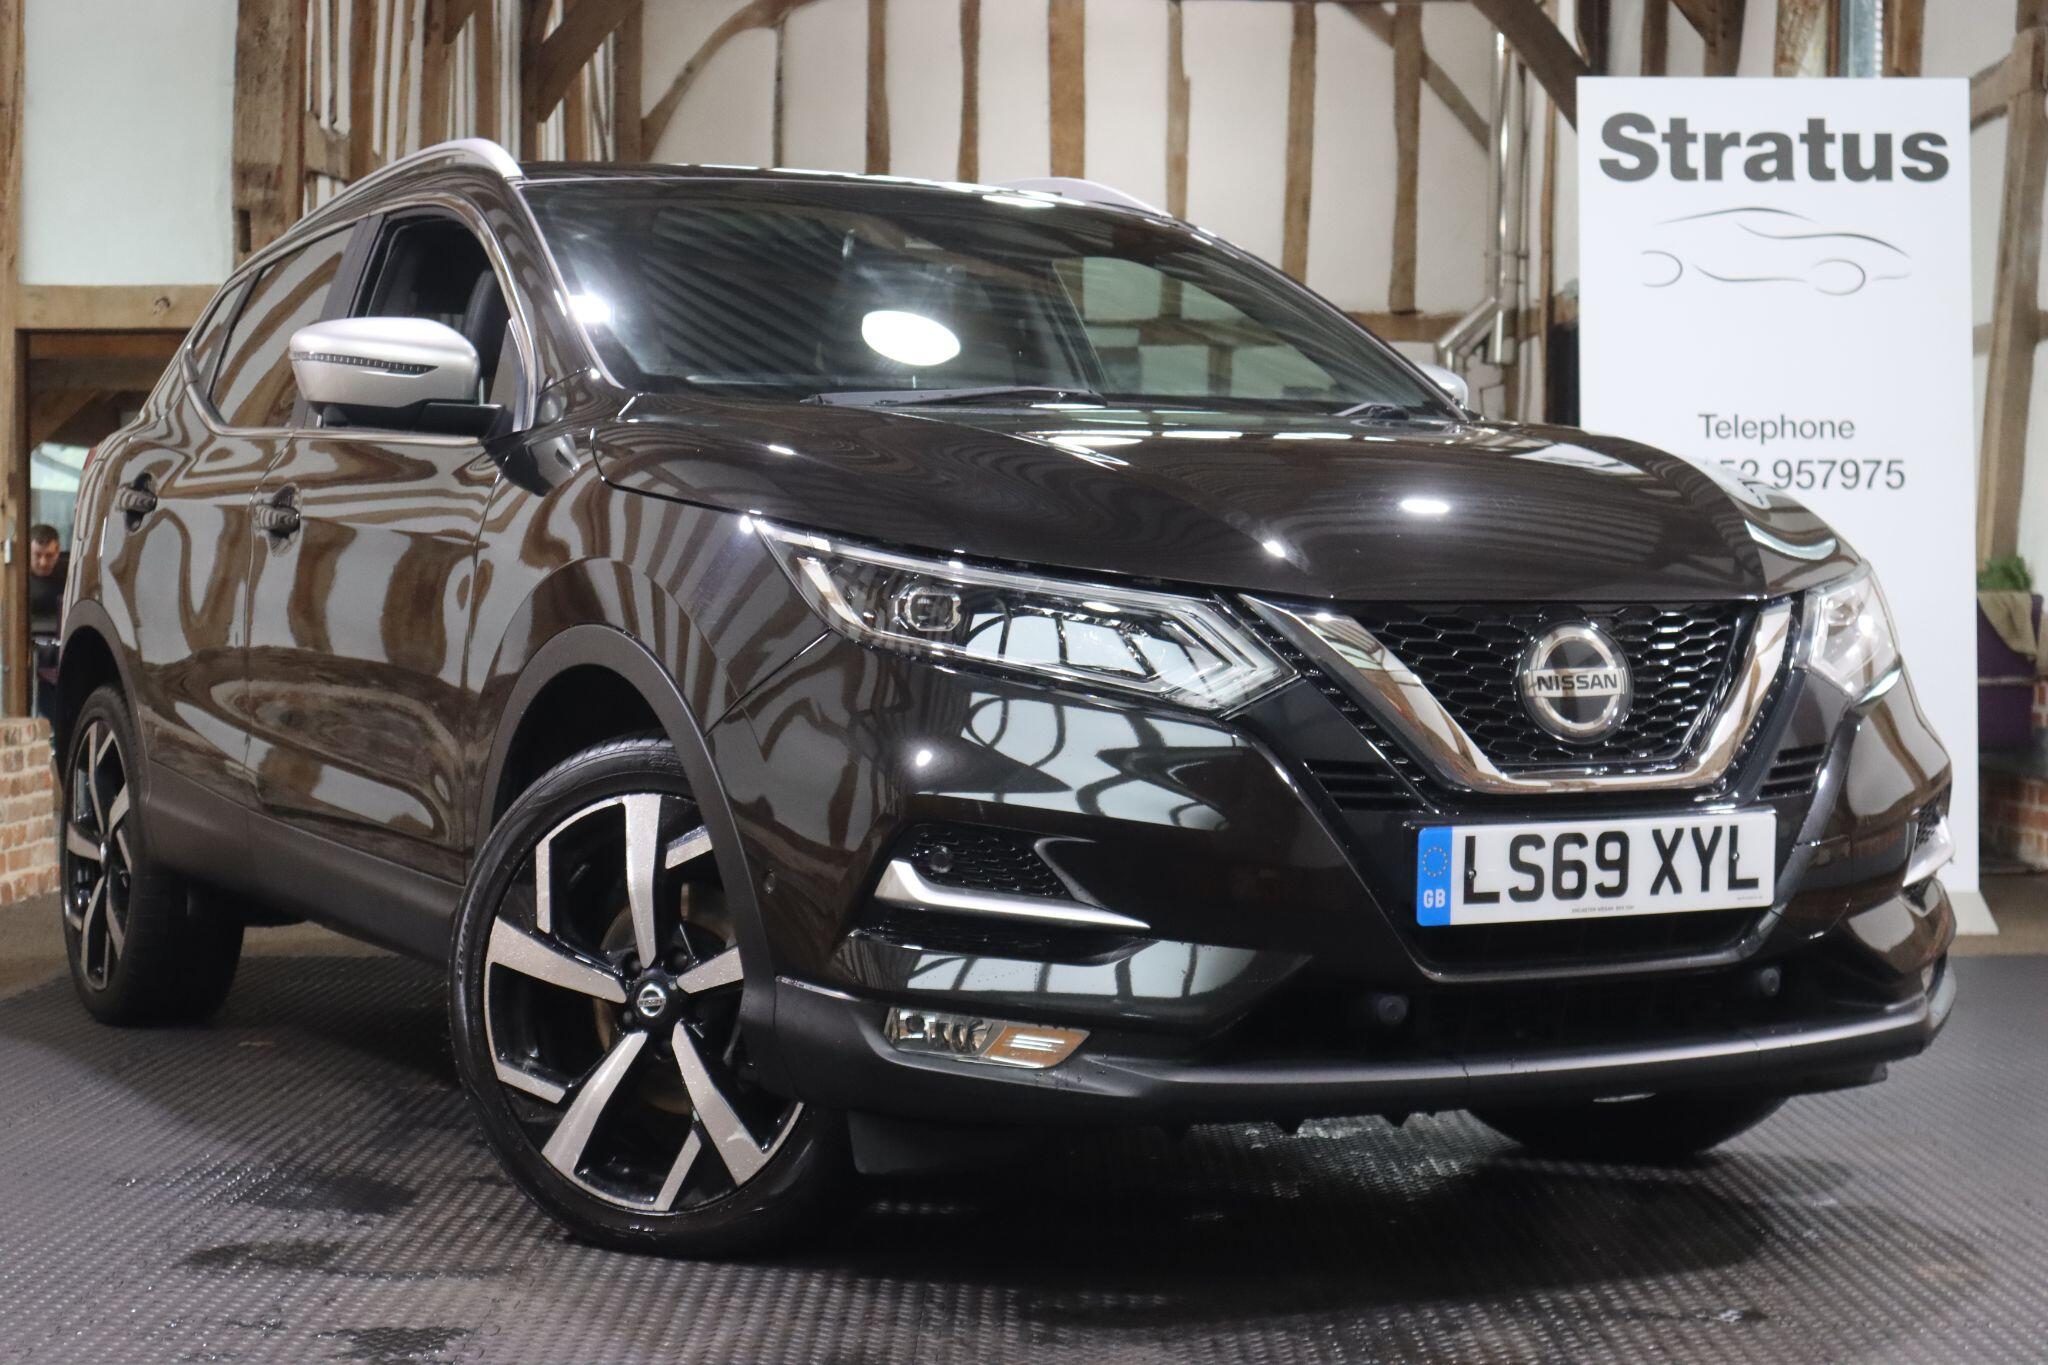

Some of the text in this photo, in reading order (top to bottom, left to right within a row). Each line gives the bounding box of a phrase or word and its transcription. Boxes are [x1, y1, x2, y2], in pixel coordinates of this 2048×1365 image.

[1599, 112, 1949, 182] Stratus
[1698, 413, 1855, 445] Telephone
[1772, 459, 1905, 490] 957975
[1536, 674, 1617, 691] NISSAN
[1463, 825, 1759, 904] LS69 XYL
[1423, 888, 1446, 909] GB
